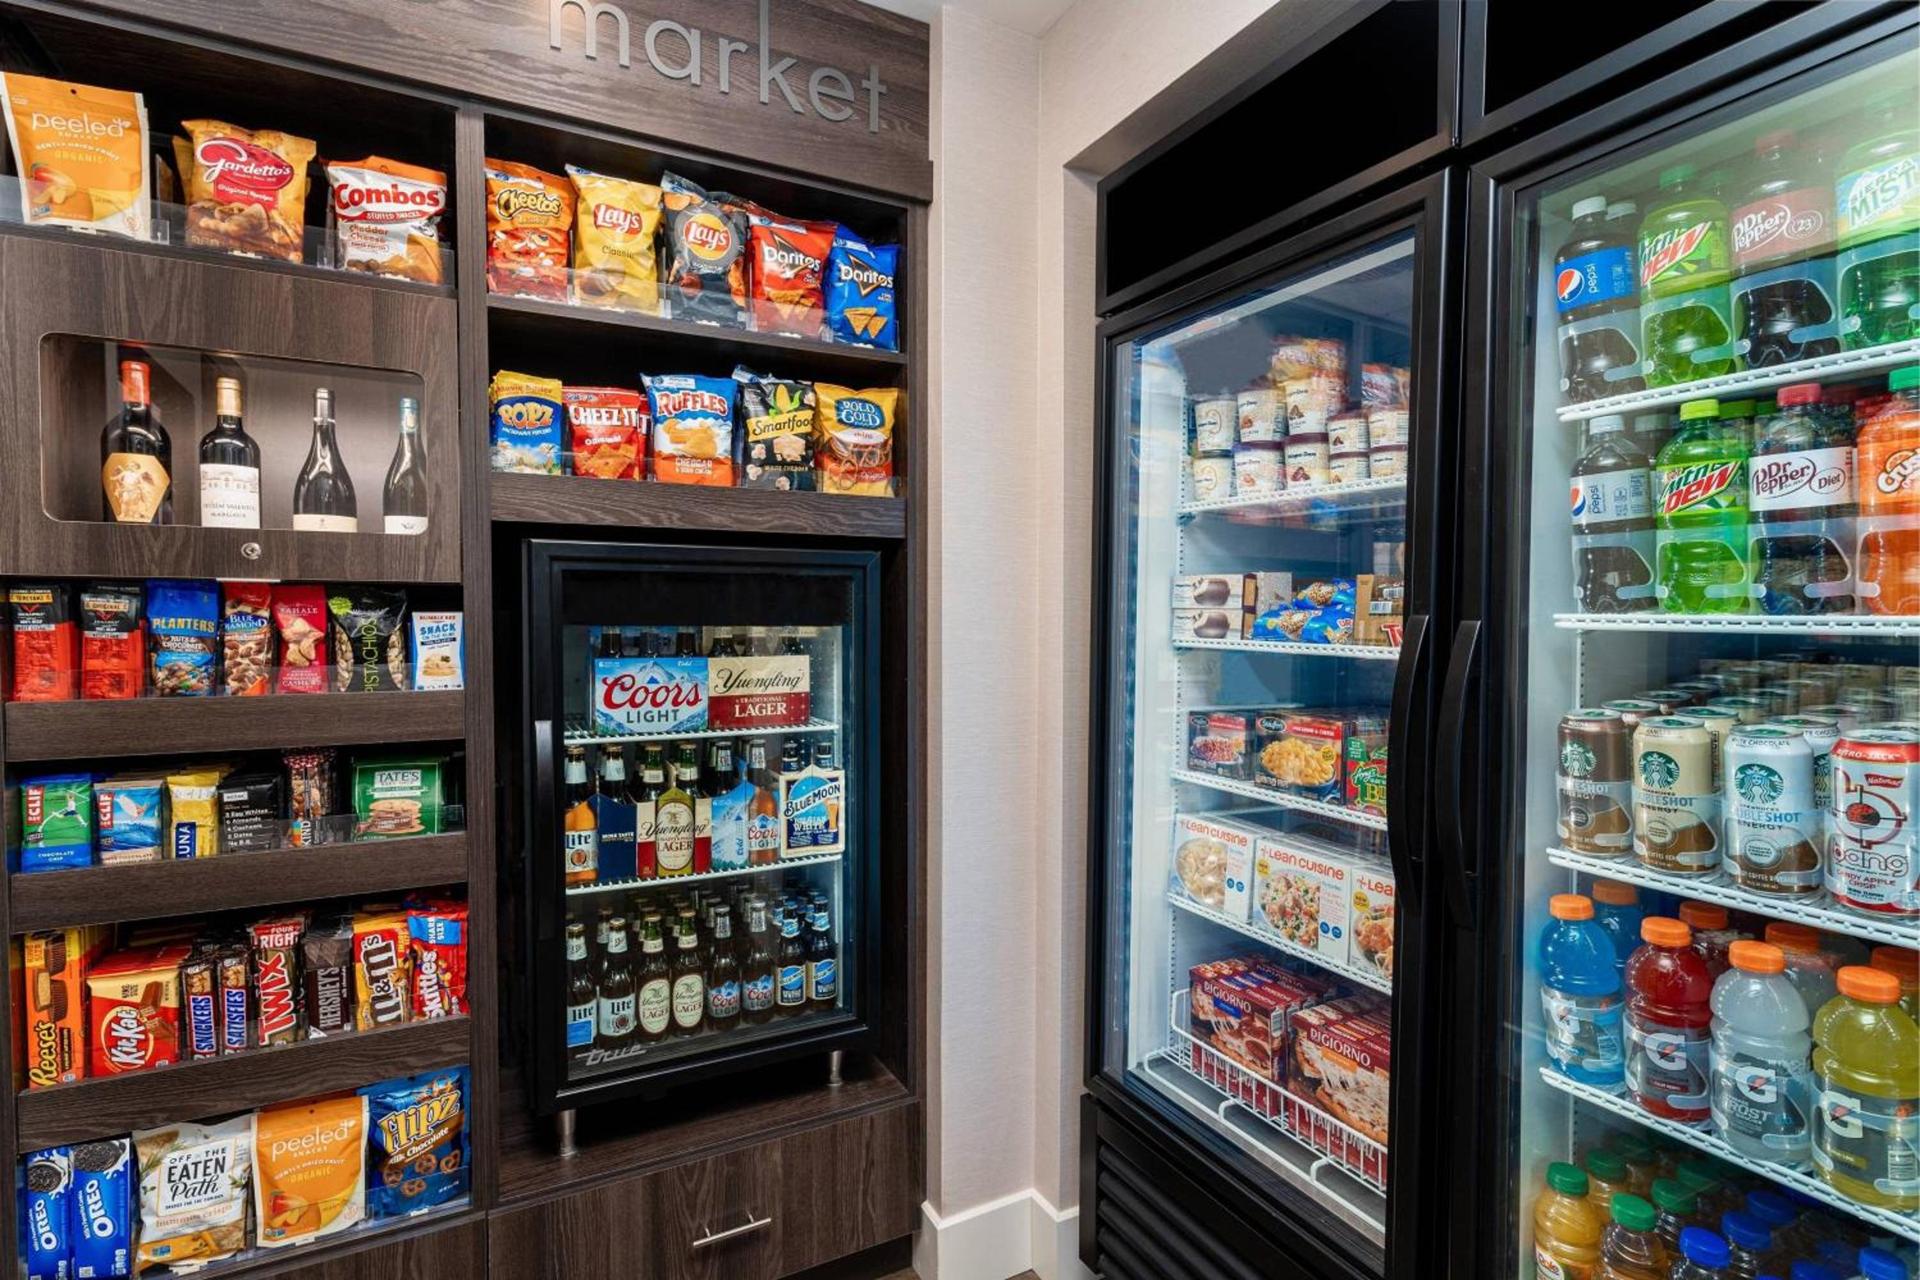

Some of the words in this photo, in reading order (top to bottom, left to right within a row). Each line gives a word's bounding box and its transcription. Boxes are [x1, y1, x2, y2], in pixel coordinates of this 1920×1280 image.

[549, 0, 887, 133] market
[32, 112, 125, 138] peeled
[197, 140, 291, 183] Gardetto's
[335, 183, 440, 210] Combos
[497, 189, 562, 221] Cheetos
[596, 205, 641, 233] Lay's
[1733, 211, 1786, 253] Pepper
[1797, 217, 1814, 231] 23
[689, 222, 728, 249] Lay's
[763, 246, 821, 272] Doritos
[840, 265, 893, 288] Doritos
[1586, 264, 1600, 295] pepsi
[569, 405, 637, 426] CHEEZ-IT
[656, 390, 728, 417] RUFFLES
[753, 414, 812, 436] Smartfoo
[842, 410, 880, 426] GOLD
[1755, 462, 1811, 495] Pepper
[1817, 473, 1841, 490] Diet
[1591, 484, 1600, 514] pepsi
[153, 617, 215, 634] PLANTERS
[230, 614, 253, 623] BLUE
[420, 622, 456, 636] SNACK
[361, 617, 379, 693] PISTACHIOS
[602, 674, 703, 710] Coors
[713, 667, 802, 695] Yuengling
[627, 708, 680, 724] LIGHT
[734, 702, 787, 718] LAGER
[377, 771, 420, 783] TATE'S
[28, 788, 42, 817] CLIF
[100, 792, 113, 820] CLIF
[784, 796, 813, 818] BLUE
[812, 783, 841, 800] MOON
[641, 821, 706, 840] Yuengling
[1185, 821, 1209, 836] Lean
[1210, 828, 1248, 848] cuisine
[1738, 819, 1783, 831] ENERGY
[566, 833, 592, 850] Lite
[1268, 849, 1297, 866] Lean
[1298, 857, 1345, 881] cuisine
[1833, 844, 1909, 878] bang
[1367, 880, 1392, 897] Lea
[259, 952, 296, 1045] TWIX
[317, 965, 341, 1028] HERSHEY'S
[610, 1000, 632, 1015] Lite
[1203, 980, 1252, 1013] DIGIORNO
[191, 995, 215, 1052] SNICKERS
[226, 989, 246, 1047] SATISFIES
[572, 1006, 594, 1021] Lite
[1309, 1028, 1371, 1067] DIGIORNO
[1644, 1032, 1687, 1071] G
[1735, 1065, 1777, 1104] G
[1726, 1099, 1773, 1122] ROST
[1821, 1090, 1864, 1139] G
[272, 1120, 349, 1162] peeled
[406, 1127, 449, 1157] Chocolate
[167, 1155, 227, 1184] EATEN
[169, 1153, 193, 1165] OFF
[204, 1146, 228, 1158] THE
[170, 1174, 220, 1202] Path
[86, 1179, 114, 1239] OREO
[35, 1199, 57, 1251] OREO
